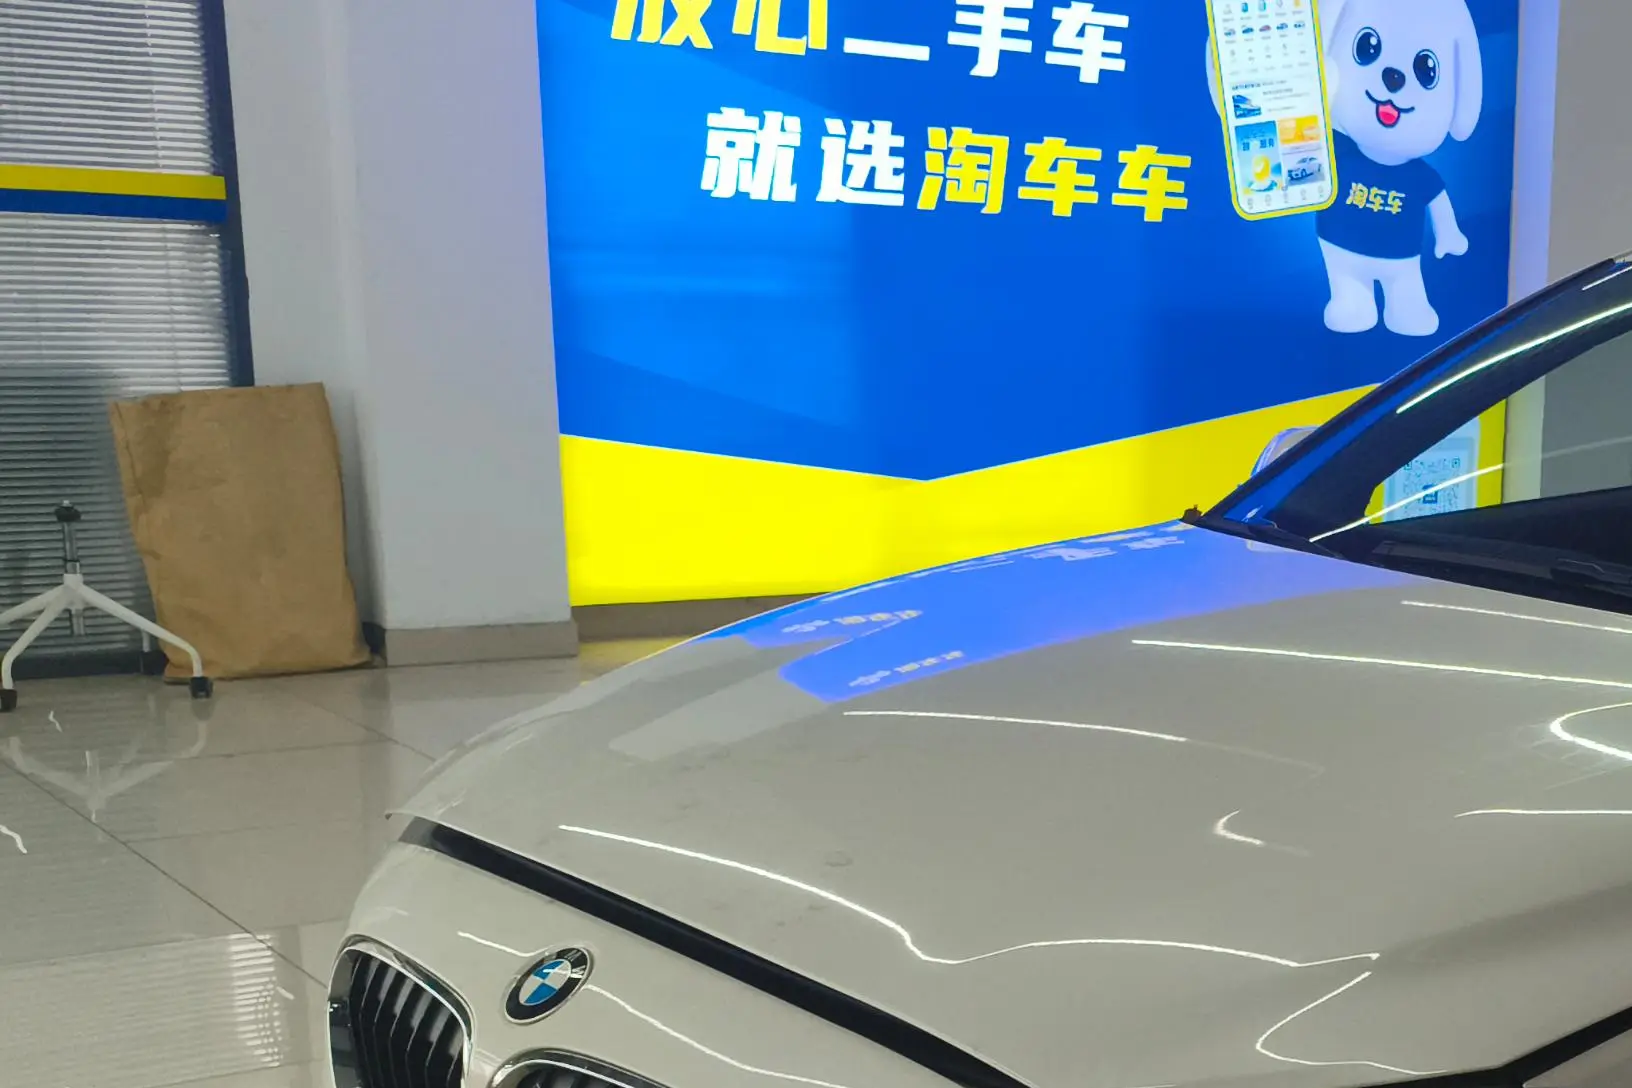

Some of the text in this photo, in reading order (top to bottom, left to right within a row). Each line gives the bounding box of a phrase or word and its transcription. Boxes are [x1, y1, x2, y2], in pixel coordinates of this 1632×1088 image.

[699, 107, 1192, 222] 就选淘车车
[1345, 182, 1406, 215] 淘车车
